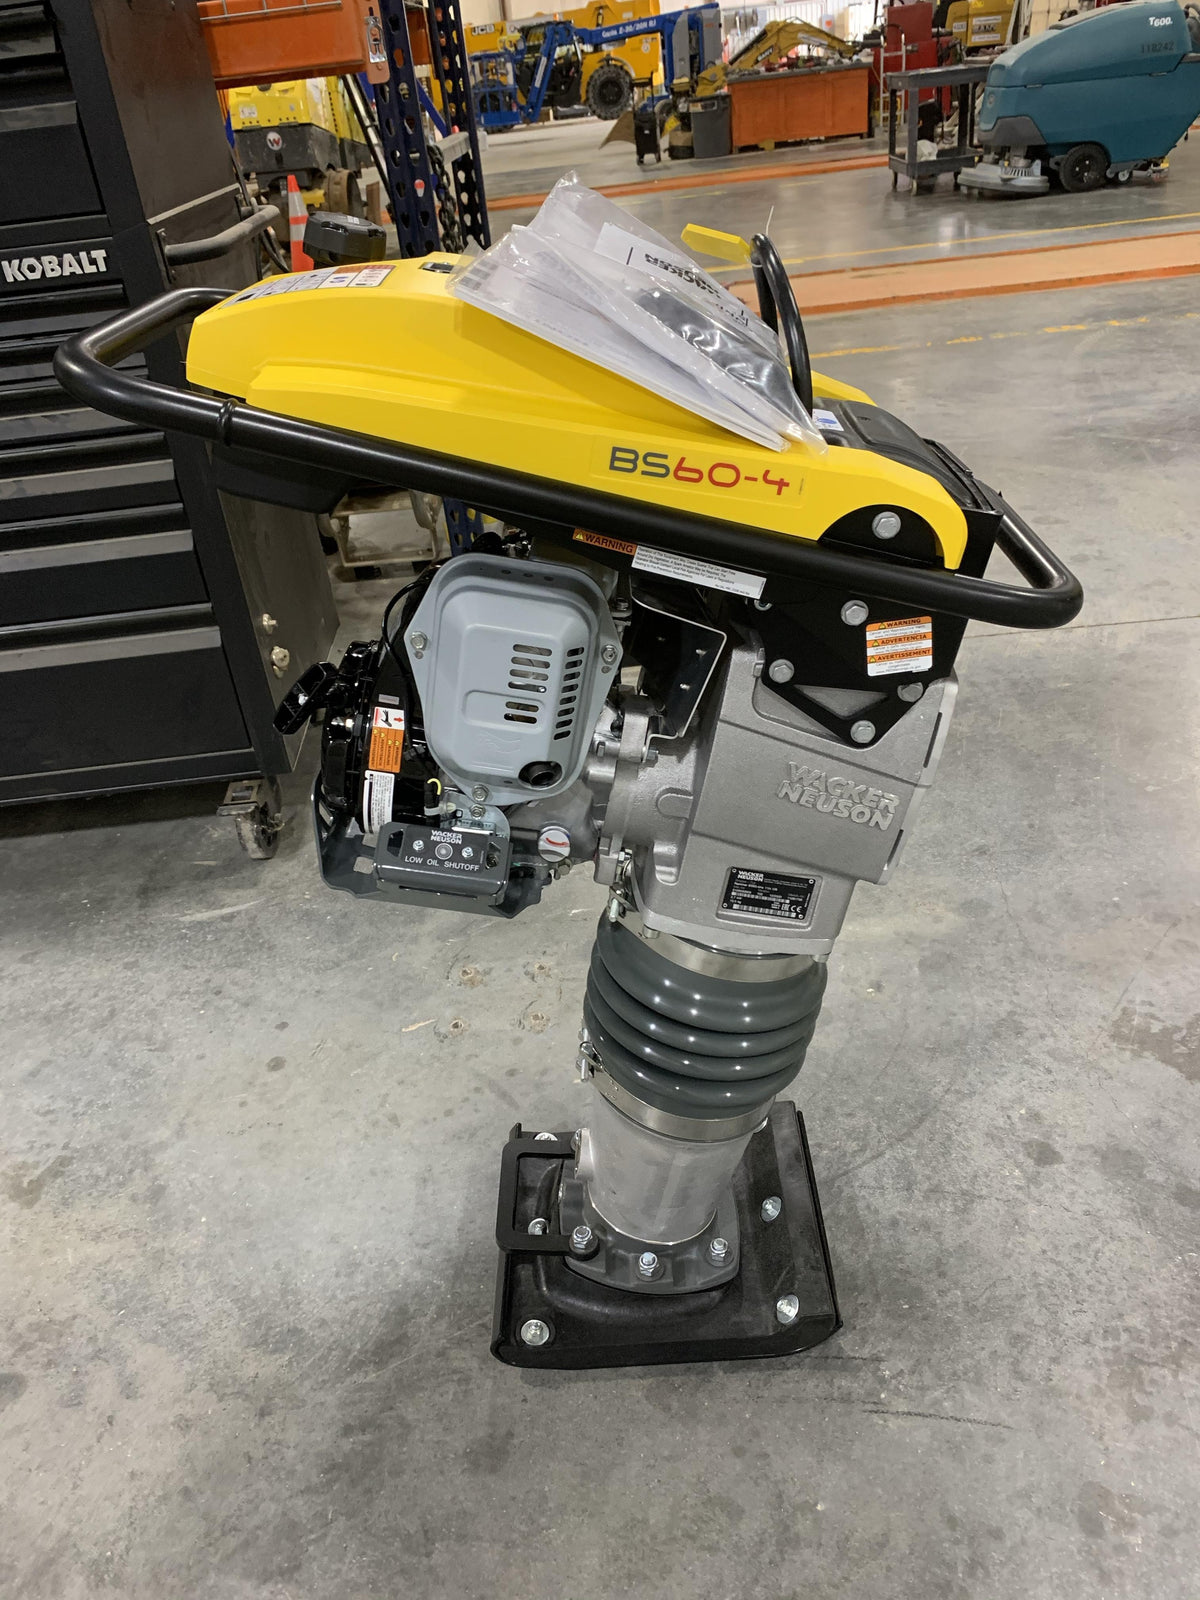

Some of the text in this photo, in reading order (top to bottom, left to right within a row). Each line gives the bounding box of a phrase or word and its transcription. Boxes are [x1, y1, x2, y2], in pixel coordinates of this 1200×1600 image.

[471, 24, 495, 36] JCB
[1, 249, 107, 283] KOBALT
[608, 446, 790, 496] BS60-4
[585, 534, 634, 554] WARNING
[887, 619, 921, 628] WARNING
[881, 634, 927, 644] ADVERTENCIA
[878, 650, 930, 660] AVERTISSEMENT
[788, 761, 900, 814] WACKER
[778, 780, 894, 830] NEUSON
[432, 830, 462, 838] WACKER
[430, 836, 462, 844] NEUSON
[404, 856, 480, 871] LOW OIL SHUTOFF
[738, 870, 764, 878] WACKER
[738, 874, 764, 882] NEUSON
